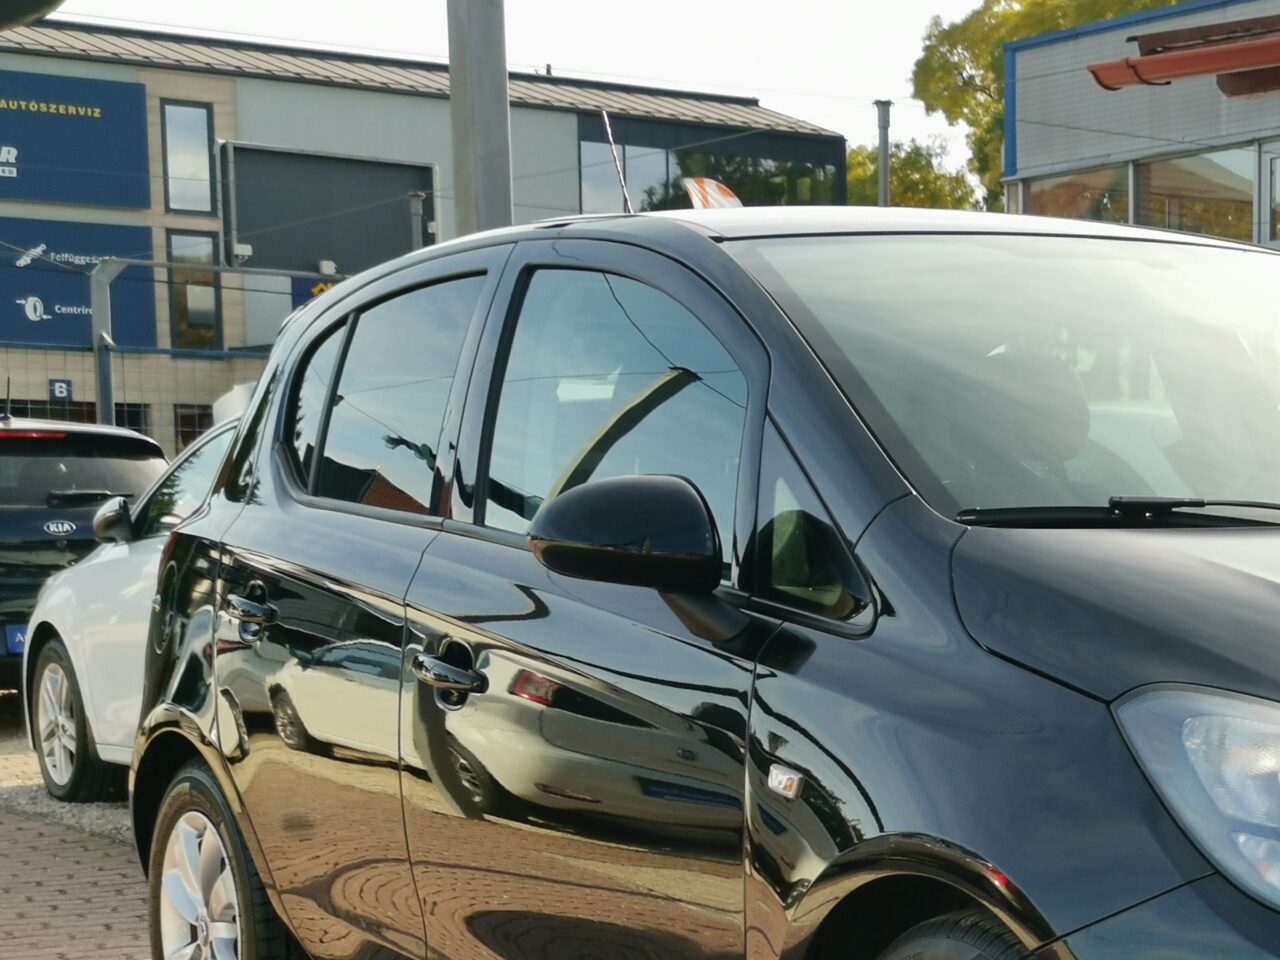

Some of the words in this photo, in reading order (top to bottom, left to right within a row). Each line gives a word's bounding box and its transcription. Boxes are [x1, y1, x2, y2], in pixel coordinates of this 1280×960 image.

[0, 99, 101, 118] AUTÓSZERVIZ
[55, 383, 67, 397] B
[49, 523, 71, 532] KIA
